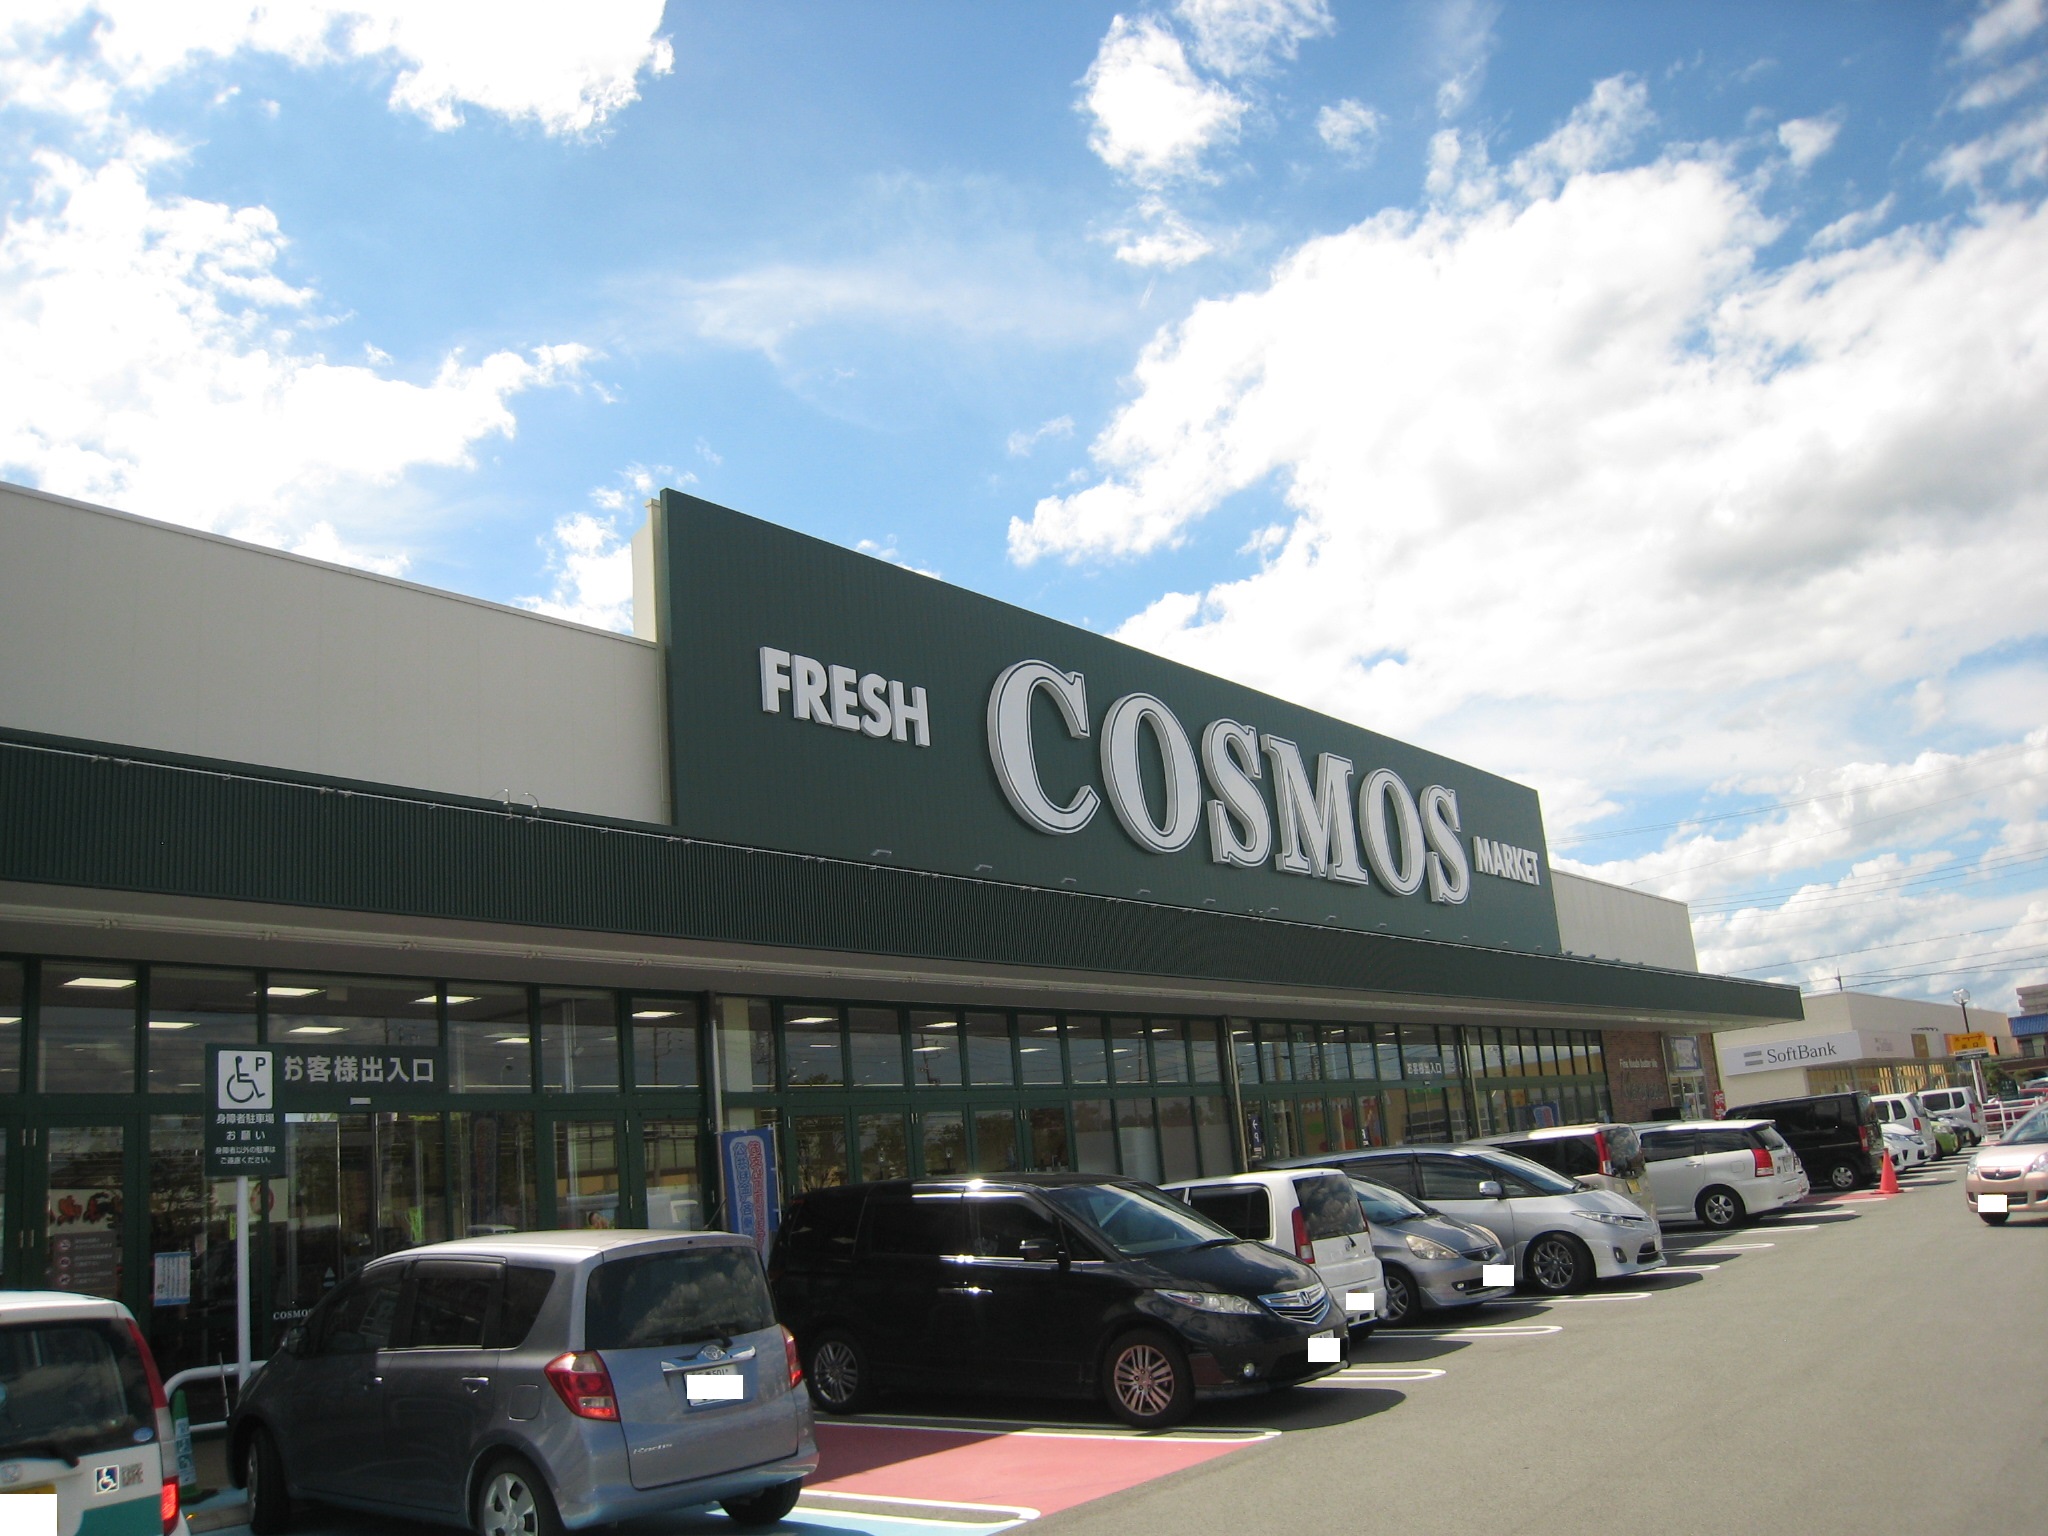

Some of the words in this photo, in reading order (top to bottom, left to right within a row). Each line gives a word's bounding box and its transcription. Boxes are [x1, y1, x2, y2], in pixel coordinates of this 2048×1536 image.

[759, 646, 931, 748] FRESH
[986, 658, 1471, 906] COSMOS
[1472, 836, 1541, 887] MARKET
[255, 1057, 266, 1071] P
[1767, 1042, 1837, 1064] SoftBank
[285, 1056, 434, 1082] お客様出入口
[216, 1113, 275, 1124] 身障者駐車場
